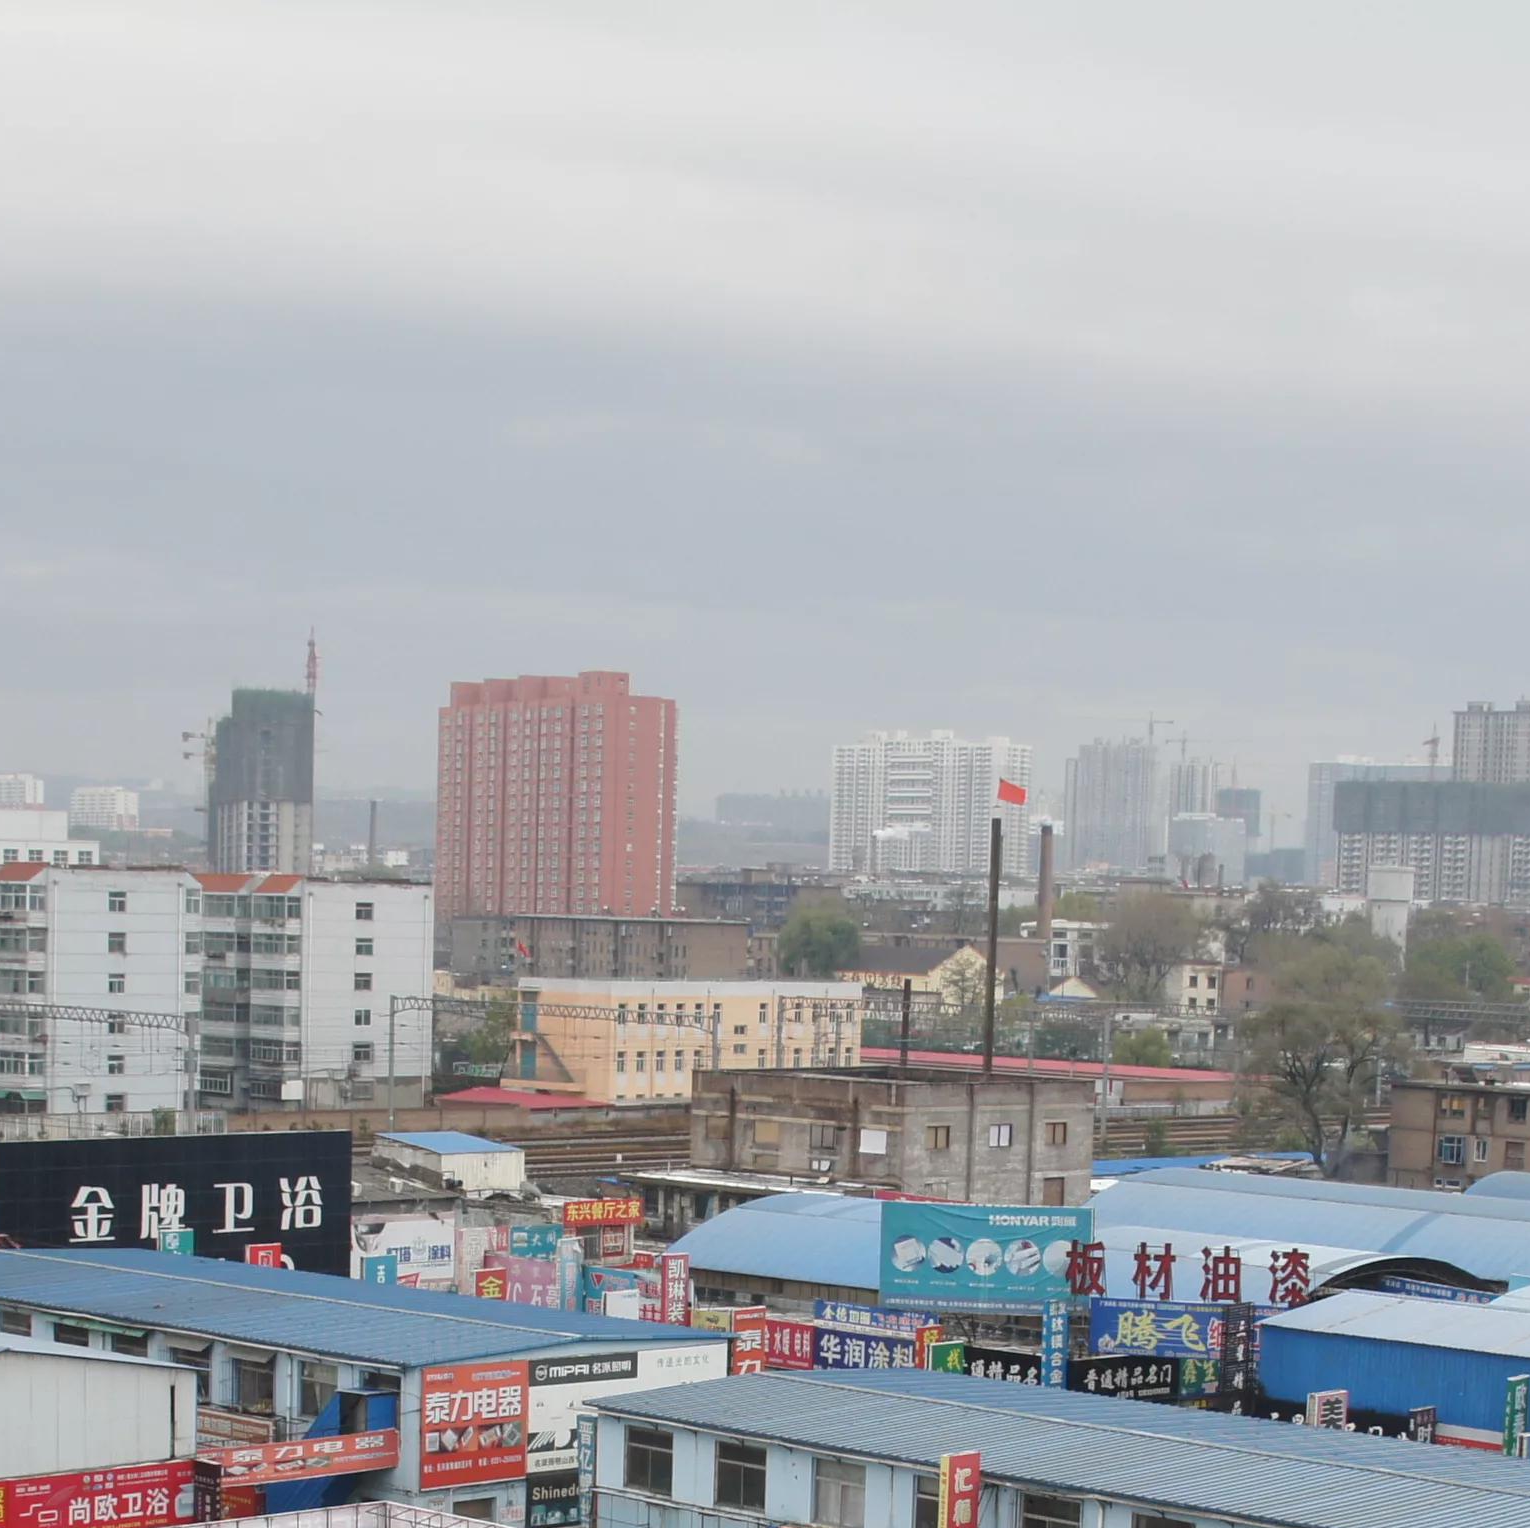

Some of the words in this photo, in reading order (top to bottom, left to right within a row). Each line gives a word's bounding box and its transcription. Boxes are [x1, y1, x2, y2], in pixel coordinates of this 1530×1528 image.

[70, 1174, 324, 1243] 金牌卫浴
[568, 1201, 641, 1221] 东兴餐厅之家
[988, 1214, 1050, 1227] HONYAR
[479, 1275, 504, 1299] 金
[1065, 1238, 1312, 1308] 板材油漆
[1114, 1310, 1208, 1353] 腾飞
[819, 1332, 915, 1369] 华润涂料
[548, 1363, 590, 1378] MIPAI
[424, 1384, 523, 1425] 泰力电器
[232, 1434, 385, 1463] 泰力电器
[68, 1488, 170, 1526] 尚欧卫浴
